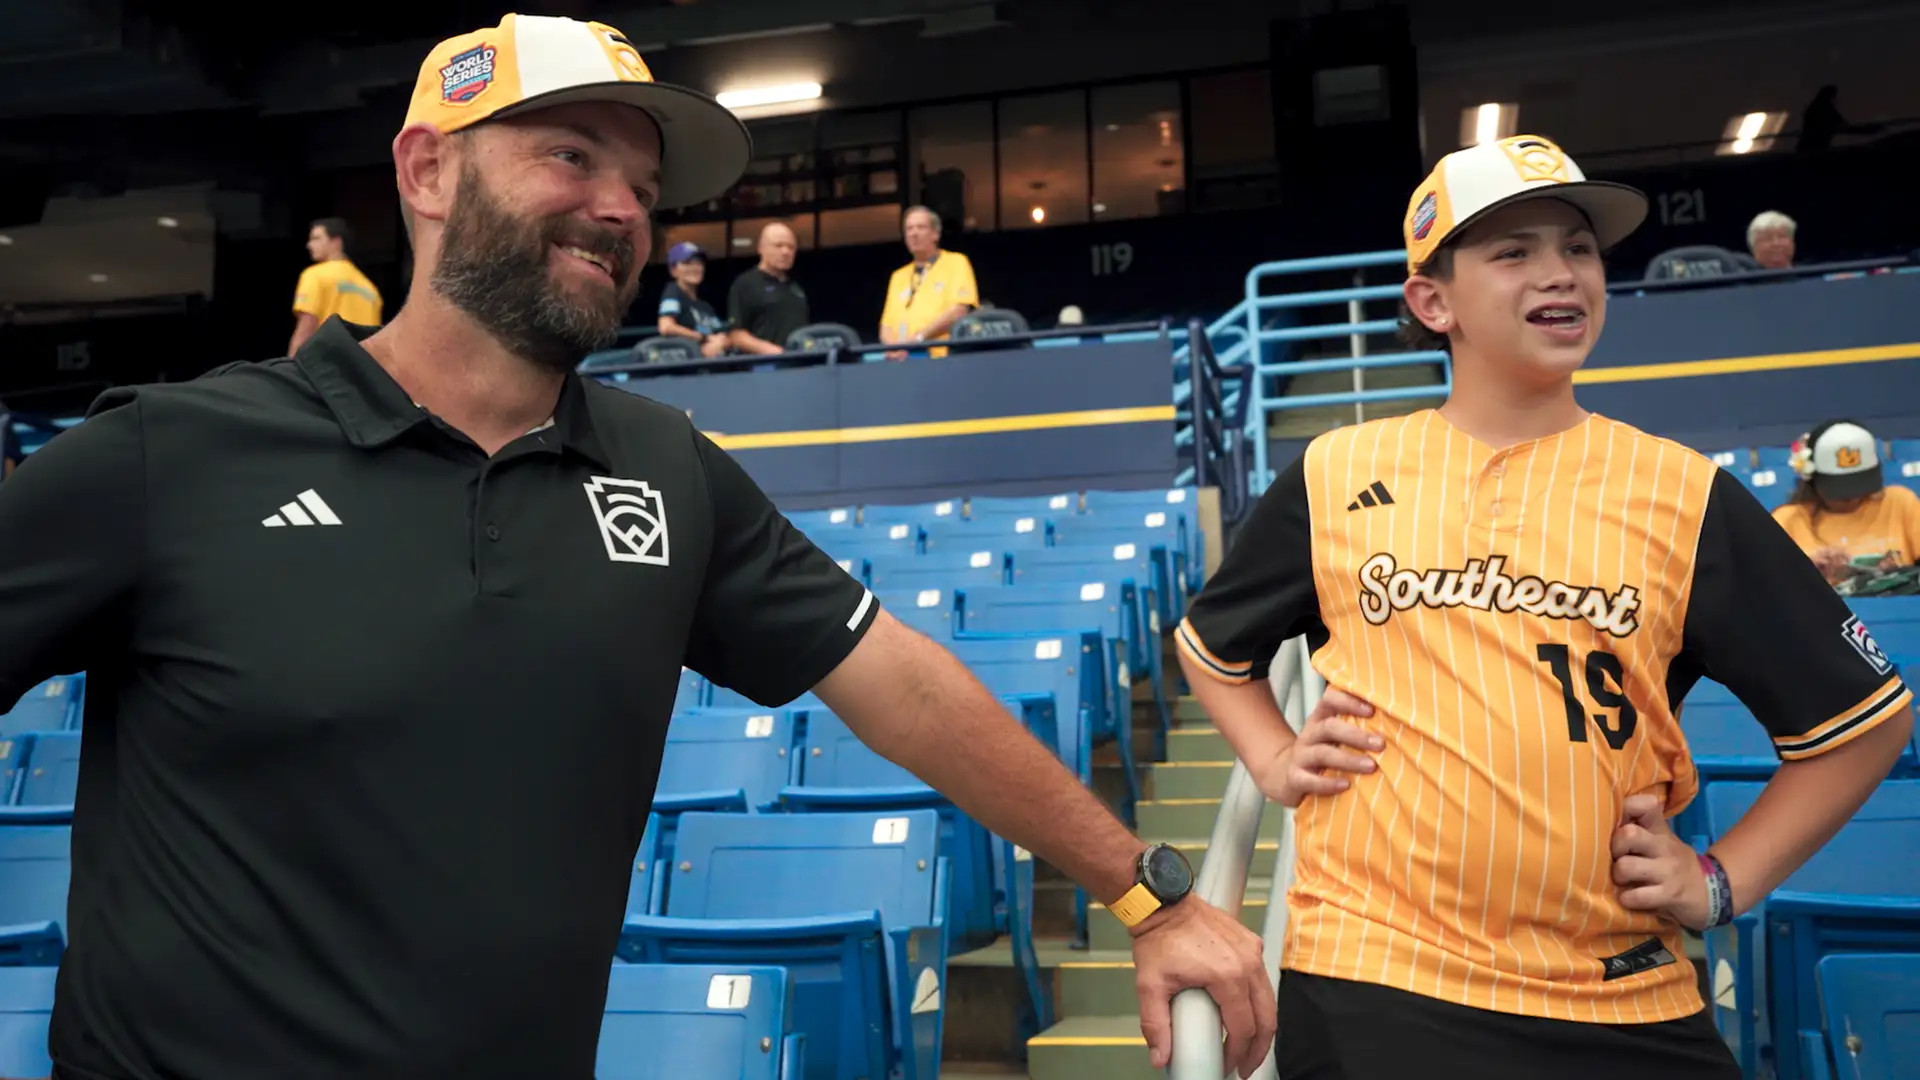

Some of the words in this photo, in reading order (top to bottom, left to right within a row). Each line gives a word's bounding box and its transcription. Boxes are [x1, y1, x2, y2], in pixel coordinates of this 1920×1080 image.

[441, 49, 495, 78] WORLD
[443, 61, 493, 89] SERIES
[1658, 188, 1706, 226] 121
[1090, 242, 1134, 277] 119
[1359, 552, 1641, 638] Southeast
[1536, 643, 1638, 750] 19
[728, 979, 736, 1006] 1
